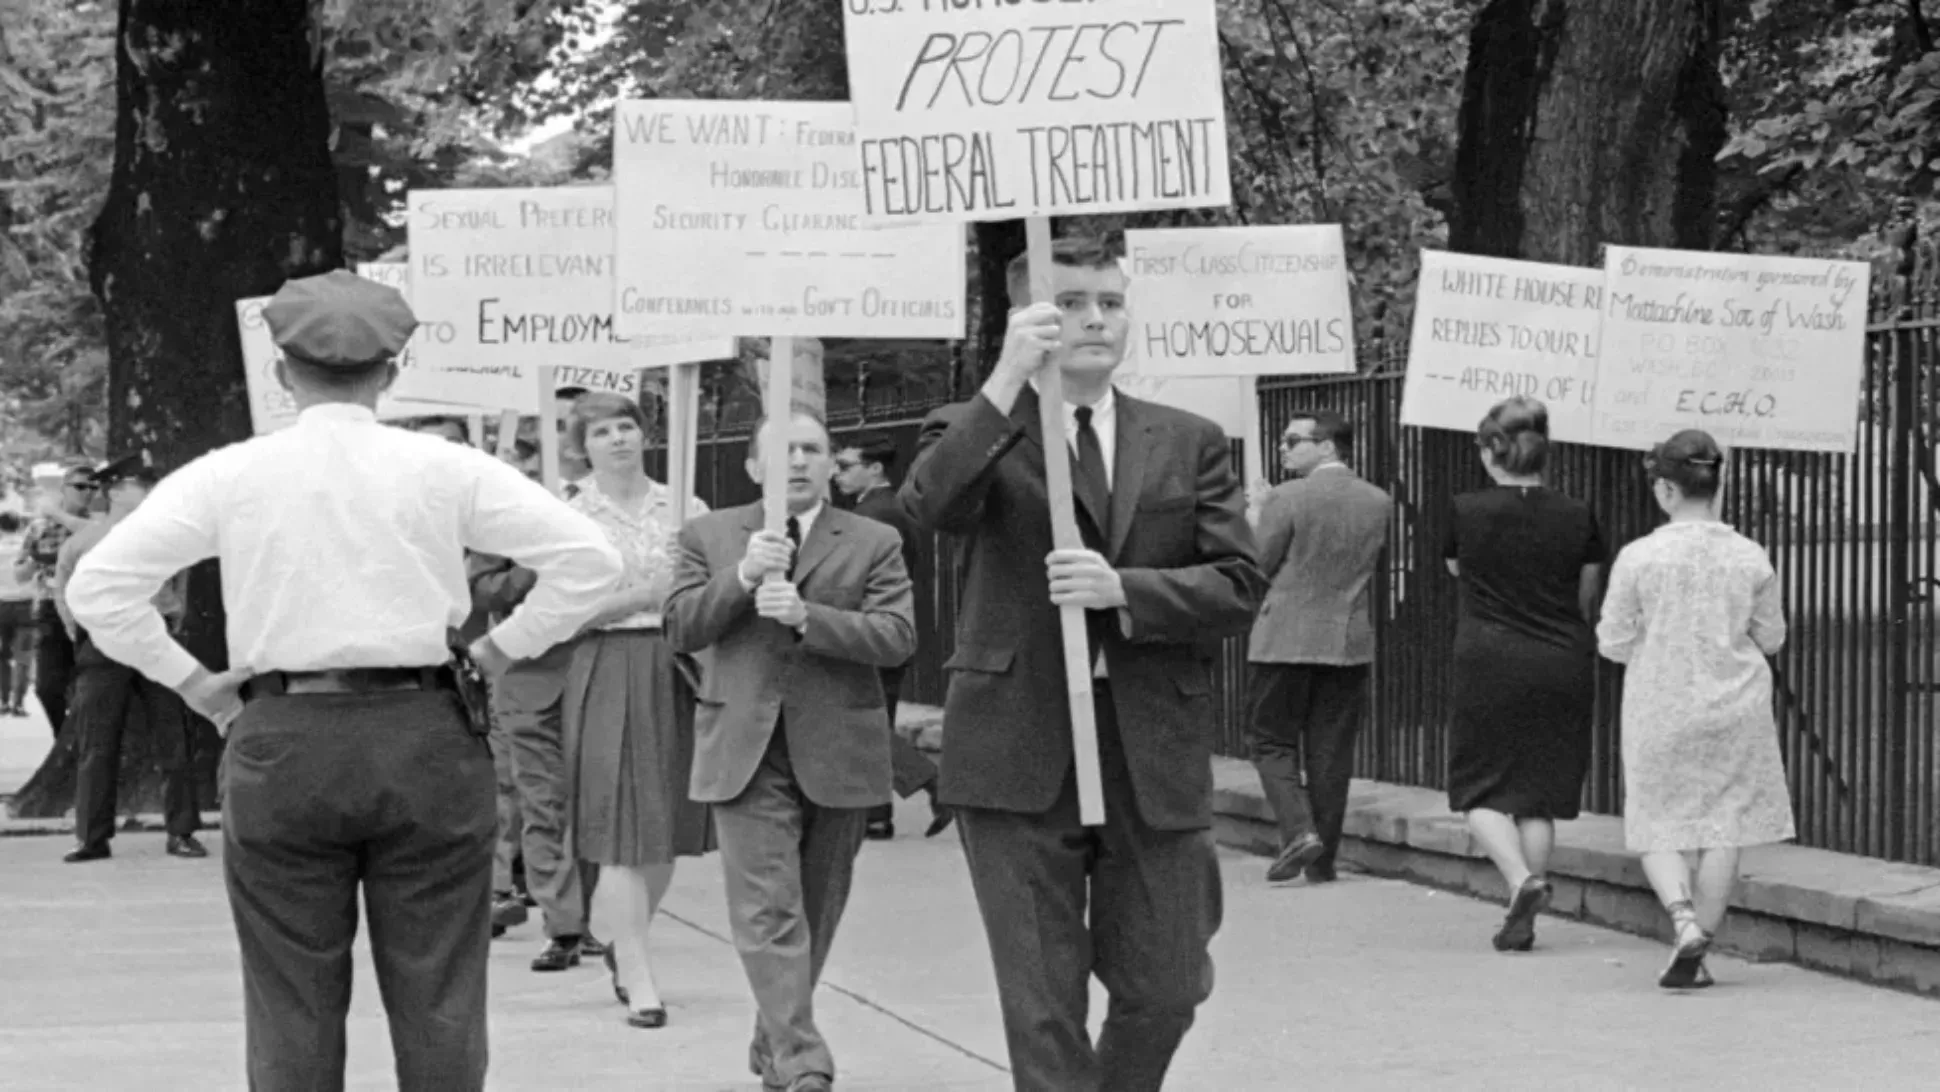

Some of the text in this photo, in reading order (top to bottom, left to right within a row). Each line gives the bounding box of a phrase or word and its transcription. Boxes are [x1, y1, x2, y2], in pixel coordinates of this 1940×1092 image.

[895, 19, 1184, 111] PROTEST
[622, 113, 677, 144] WE
[796, 121, 856, 146] FEDERA
[812, 161, 860, 188] DISC
[861, 118, 1215, 215] FEDERAL TREATMENT
[418, 201, 506, 229] SEXUAL
[652, 204, 747, 230] SECURITY
[421, 254, 448, 277] IS
[1213, 293, 1253, 309] FOR
[1441, 269, 1508, 300] WHITE
[1512, 277, 1576, 309] HOUSE
[417, 320, 456, 344] TO
[1145, 318, 1345, 358] HOMOSEXUALS
[1432, 317, 1500, 347] REPLIES
[1507, 324, 1532, 349] TO
[1534, 330, 1579, 357] OUR
[553, 366, 633, 393] ITIZENS
[1546, 376, 1573, 401] OF
